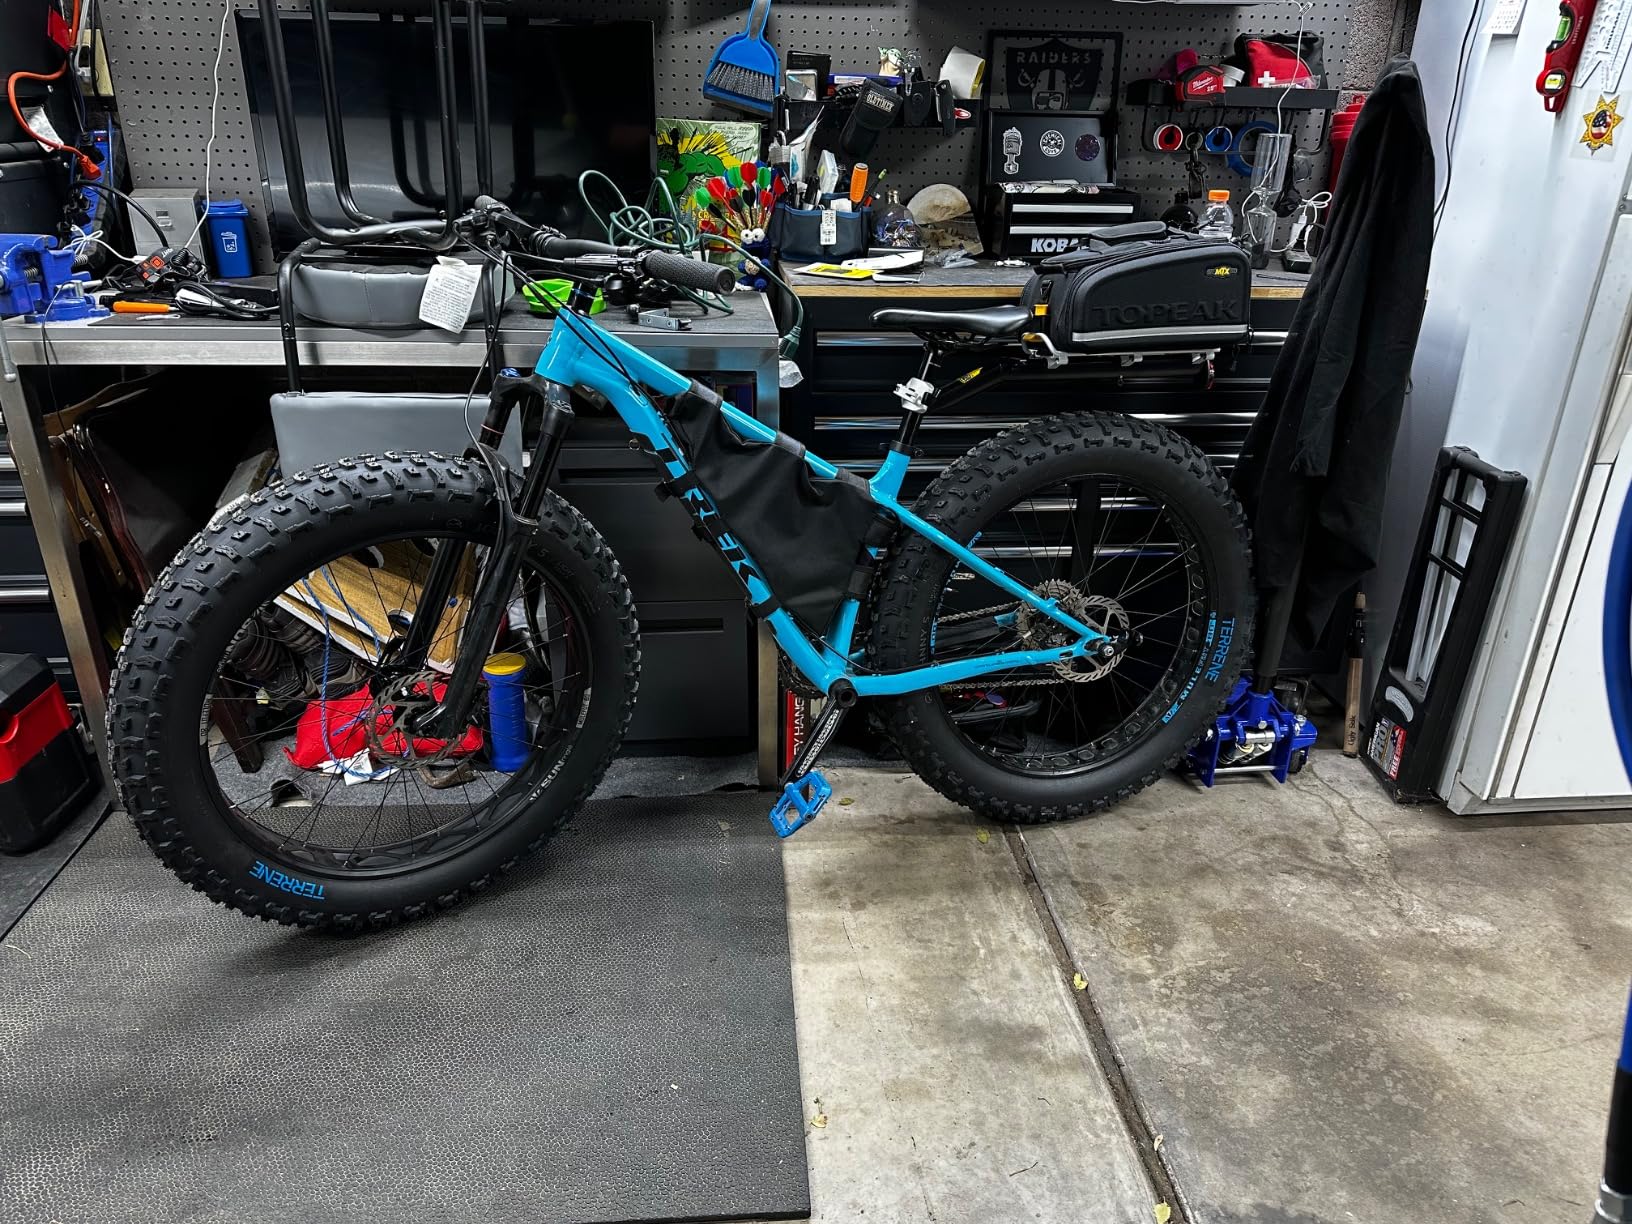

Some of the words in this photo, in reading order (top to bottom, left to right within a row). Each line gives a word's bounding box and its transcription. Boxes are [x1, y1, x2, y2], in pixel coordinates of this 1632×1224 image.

[1016, 51, 1091, 64] RAIDERS
[1031, 237, 1089, 253] KOBA
[1091, 299, 1241, 328] TOPEAK
[656, 432, 764, 584] TREK
[1205, 617, 1235, 683] TERRENE
[1373, 725, 1388, 764] PRO
[249, 860, 325, 900] TERRENE
